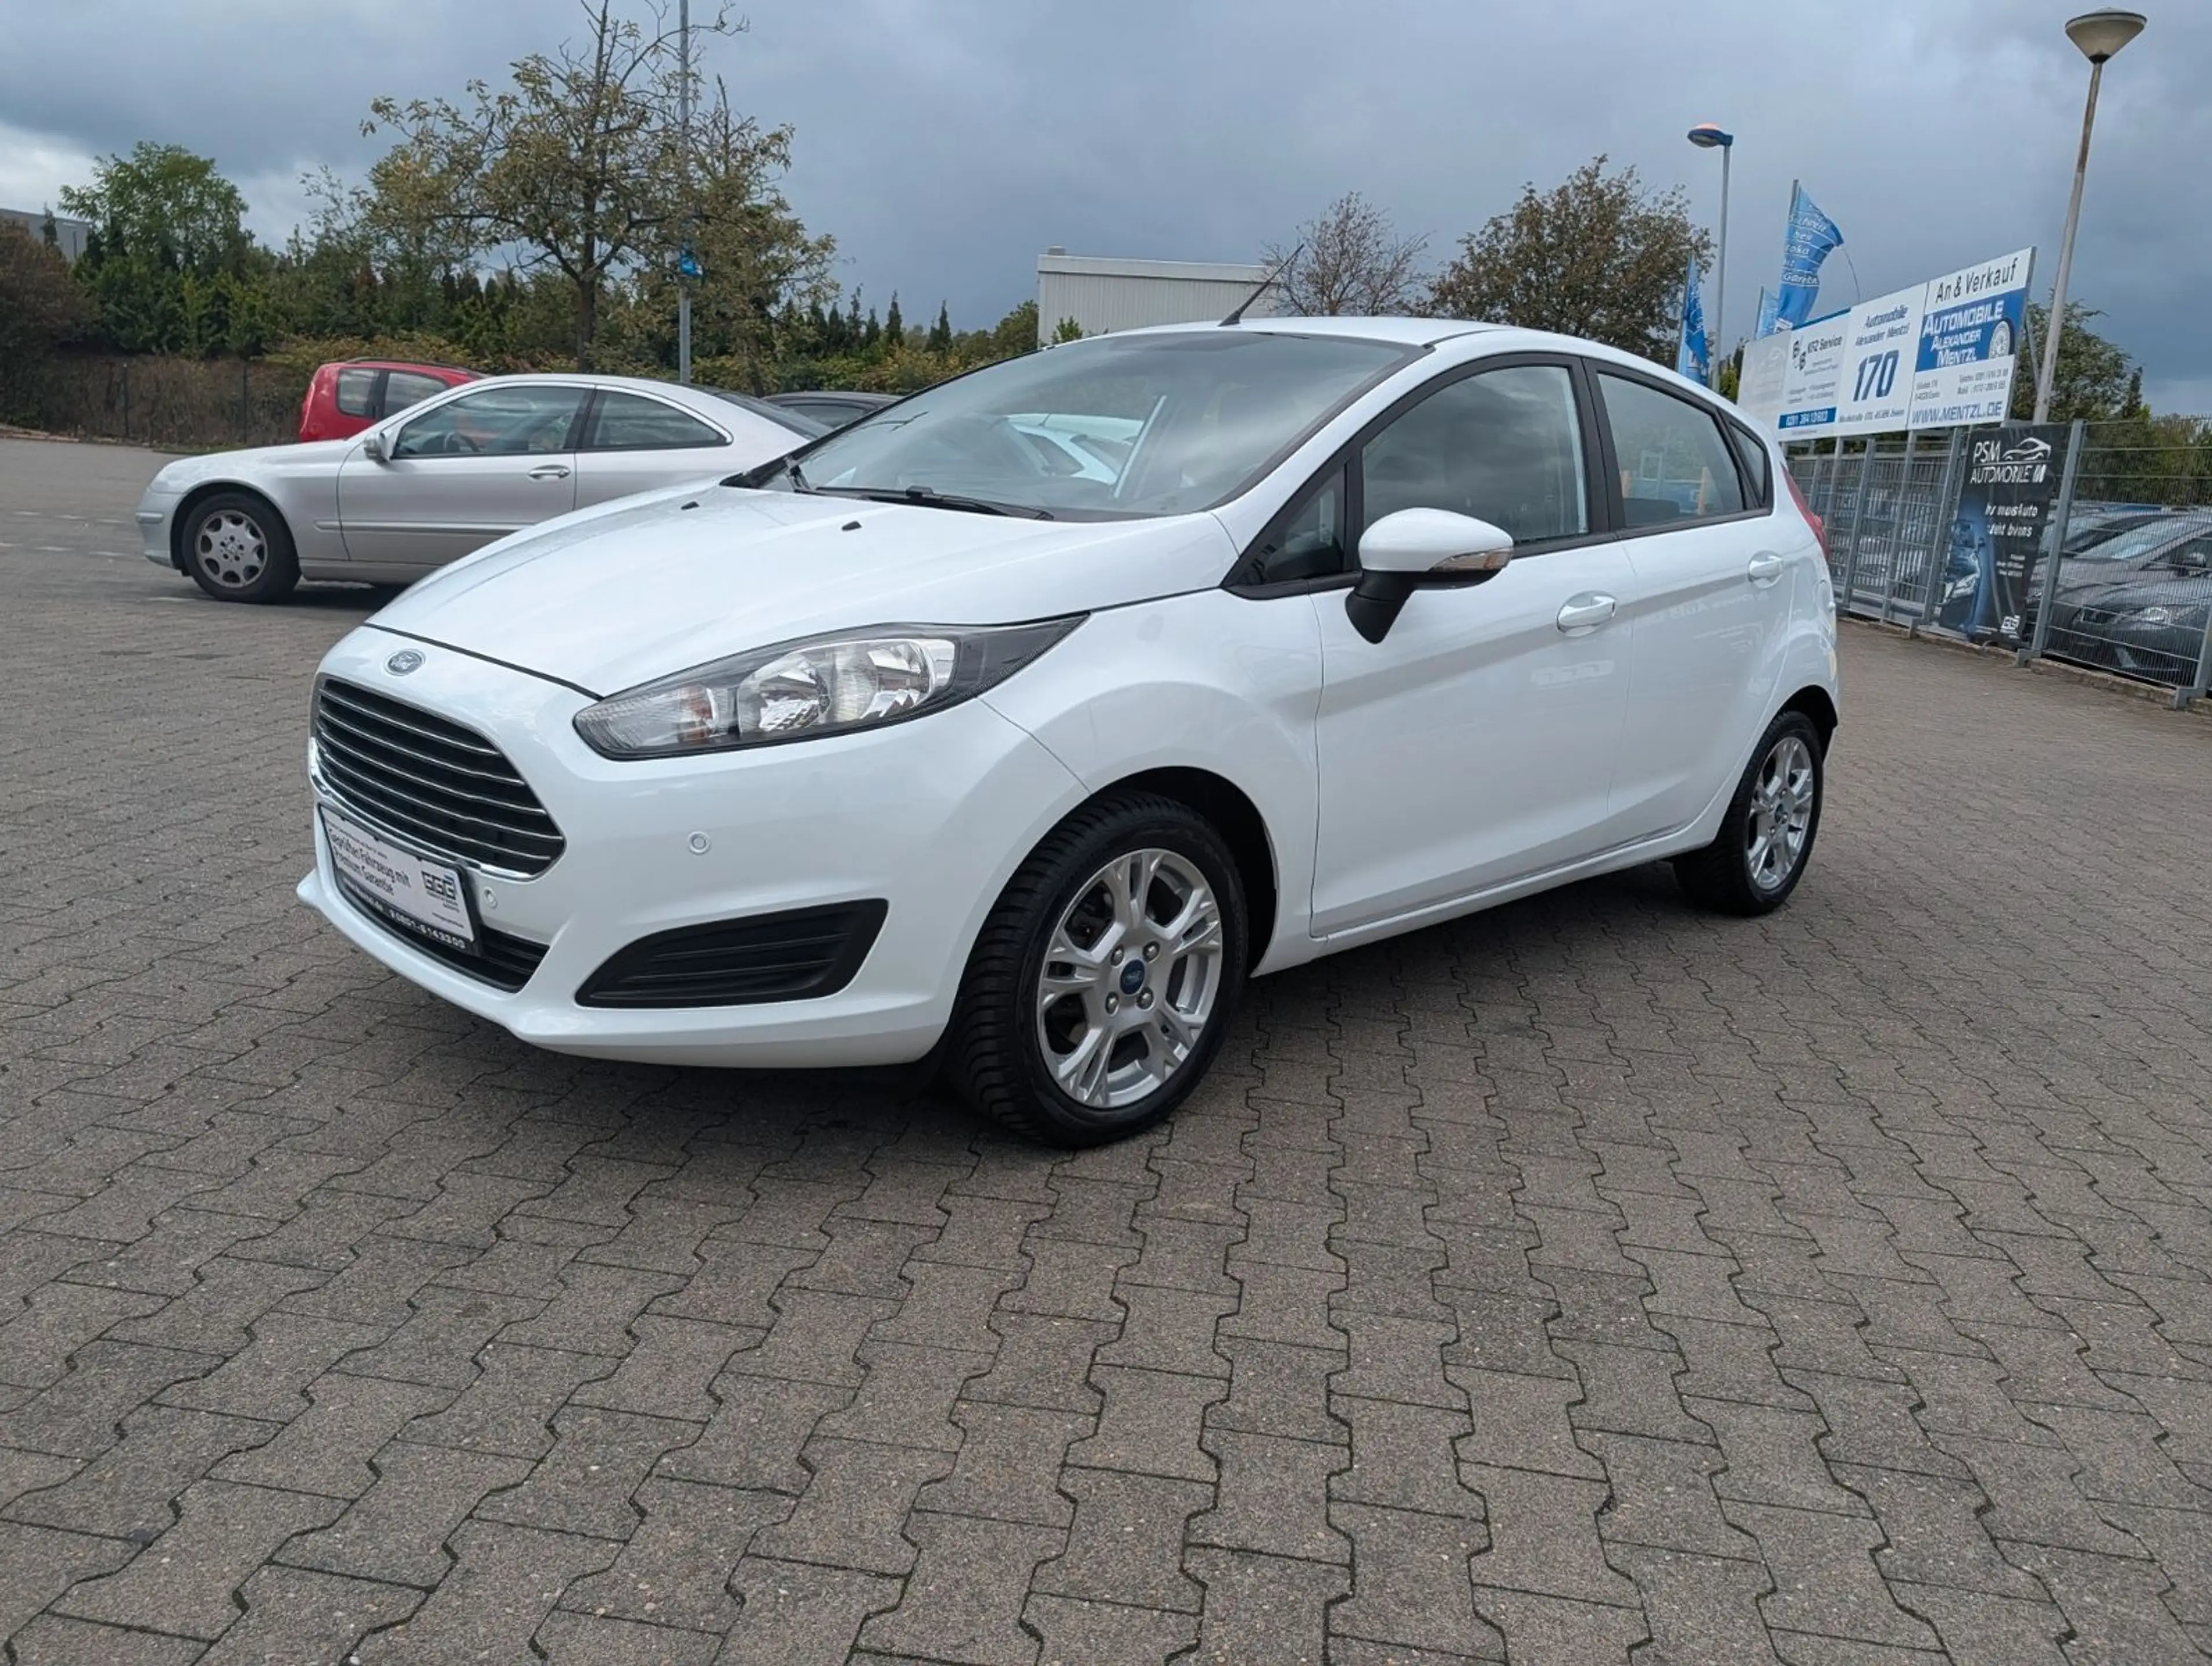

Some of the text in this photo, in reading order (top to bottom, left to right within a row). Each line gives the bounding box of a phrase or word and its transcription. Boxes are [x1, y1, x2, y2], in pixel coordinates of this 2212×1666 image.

[1935, 257, 2018, 303] An & Verkauf
[1923, 300, 2003, 337] AUTOMOBILE
[1819, 334, 1843, 351] Service
[1931, 329, 1982, 352] ALEXANDER
[1937, 347, 1977, 367] MENTZL
[1853, 349, 1899, 401] 170
[1912, 400, 2003, 423] WWW.MENTZL.DE
[1973, 441, 2001, 463] PSM
